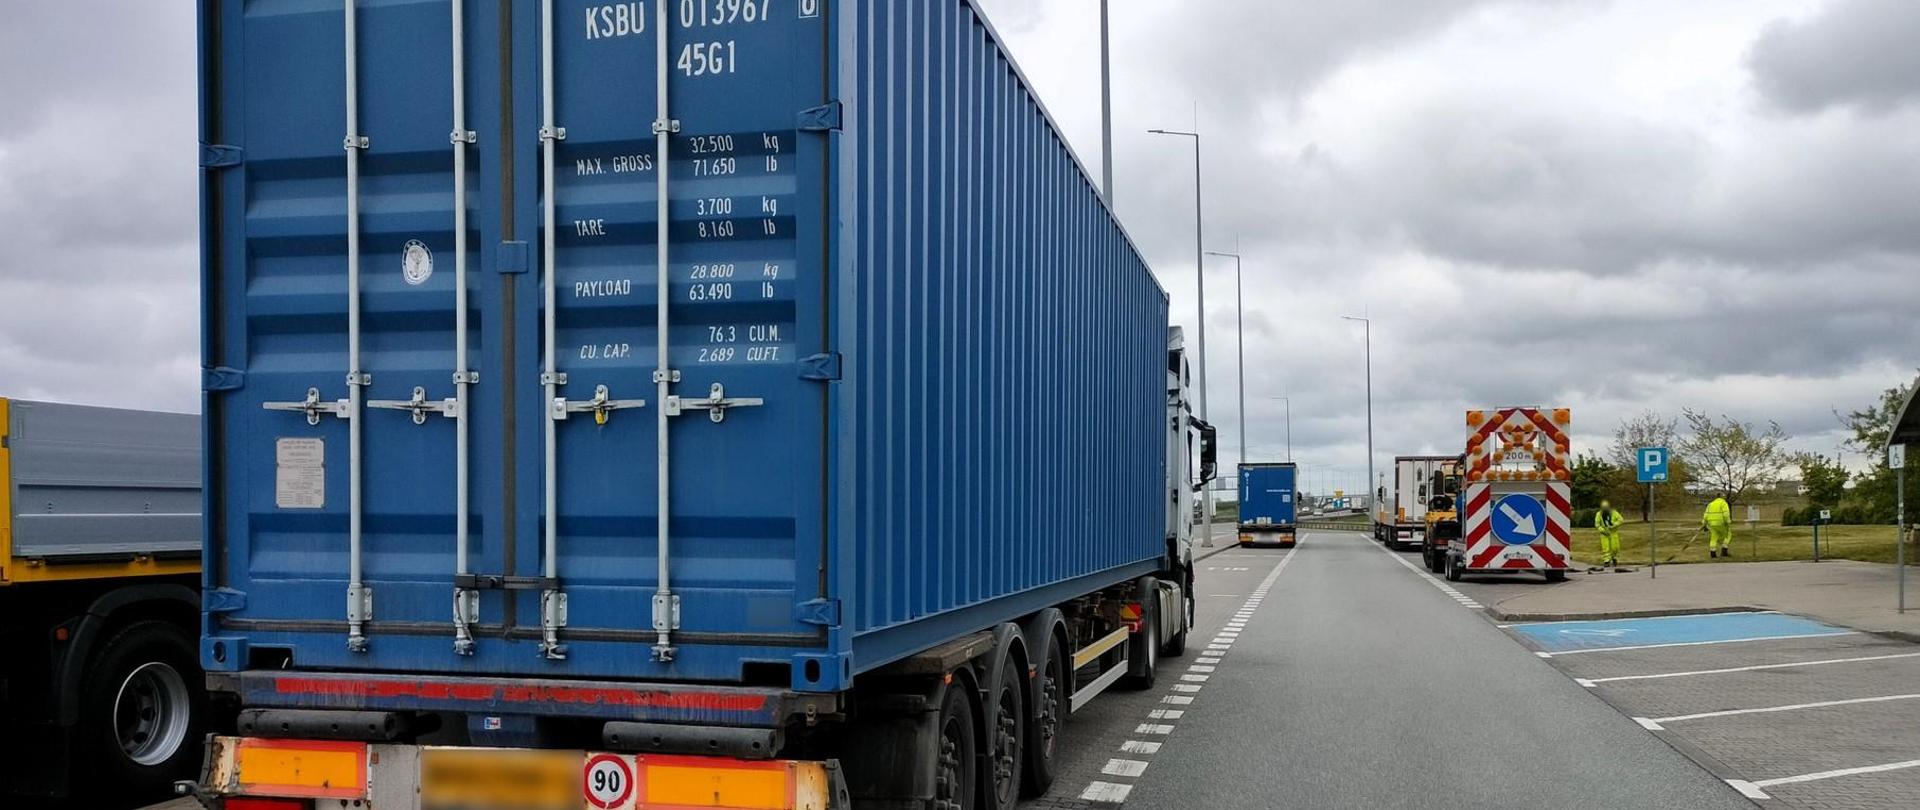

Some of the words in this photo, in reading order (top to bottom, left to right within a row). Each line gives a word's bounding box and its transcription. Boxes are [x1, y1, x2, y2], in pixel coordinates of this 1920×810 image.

[585, 1, 645, 40] KSBU
[680, 0, 769, 28] 013967
[677, 40, 736, 76] 45G1
[690, 134, 734, 153] 32.500
[763, 132, 779, 152] kg
[576, 156, 606, 176] MAX.
[613, 154, 652, 173] GROSS
[693, 157, 736, 176] 71.650
[765, 155, 777, 172] lb
[697, 197, 732, 215] 3.700
[762, 196, 777, 216] kg
[574, 218, 606, 236] TARE
[698, 220, 734, 238] 8.160
[763, 219, 776, 235] lb
[690, 264, 734, 280] 28.800
[763, 262, 779, 280] kg
[575, 279, 631, 298] PAYLOAD
[689, 283, 732, 301] 63.490
[762, 282, 774, 298] lb
[708, 326, 736, 343] 76.3
[749, 325, 781, 342] CU.M.
[580, 345, 599, 360] CU.
[603, 343, 631, 359] CAP.
[698, 347, 734, 362] 2.689
[1505, 452, 1523, 460] 200
[1644, 450, 1662, 472] P
[594, 769, 620, 792] 90
